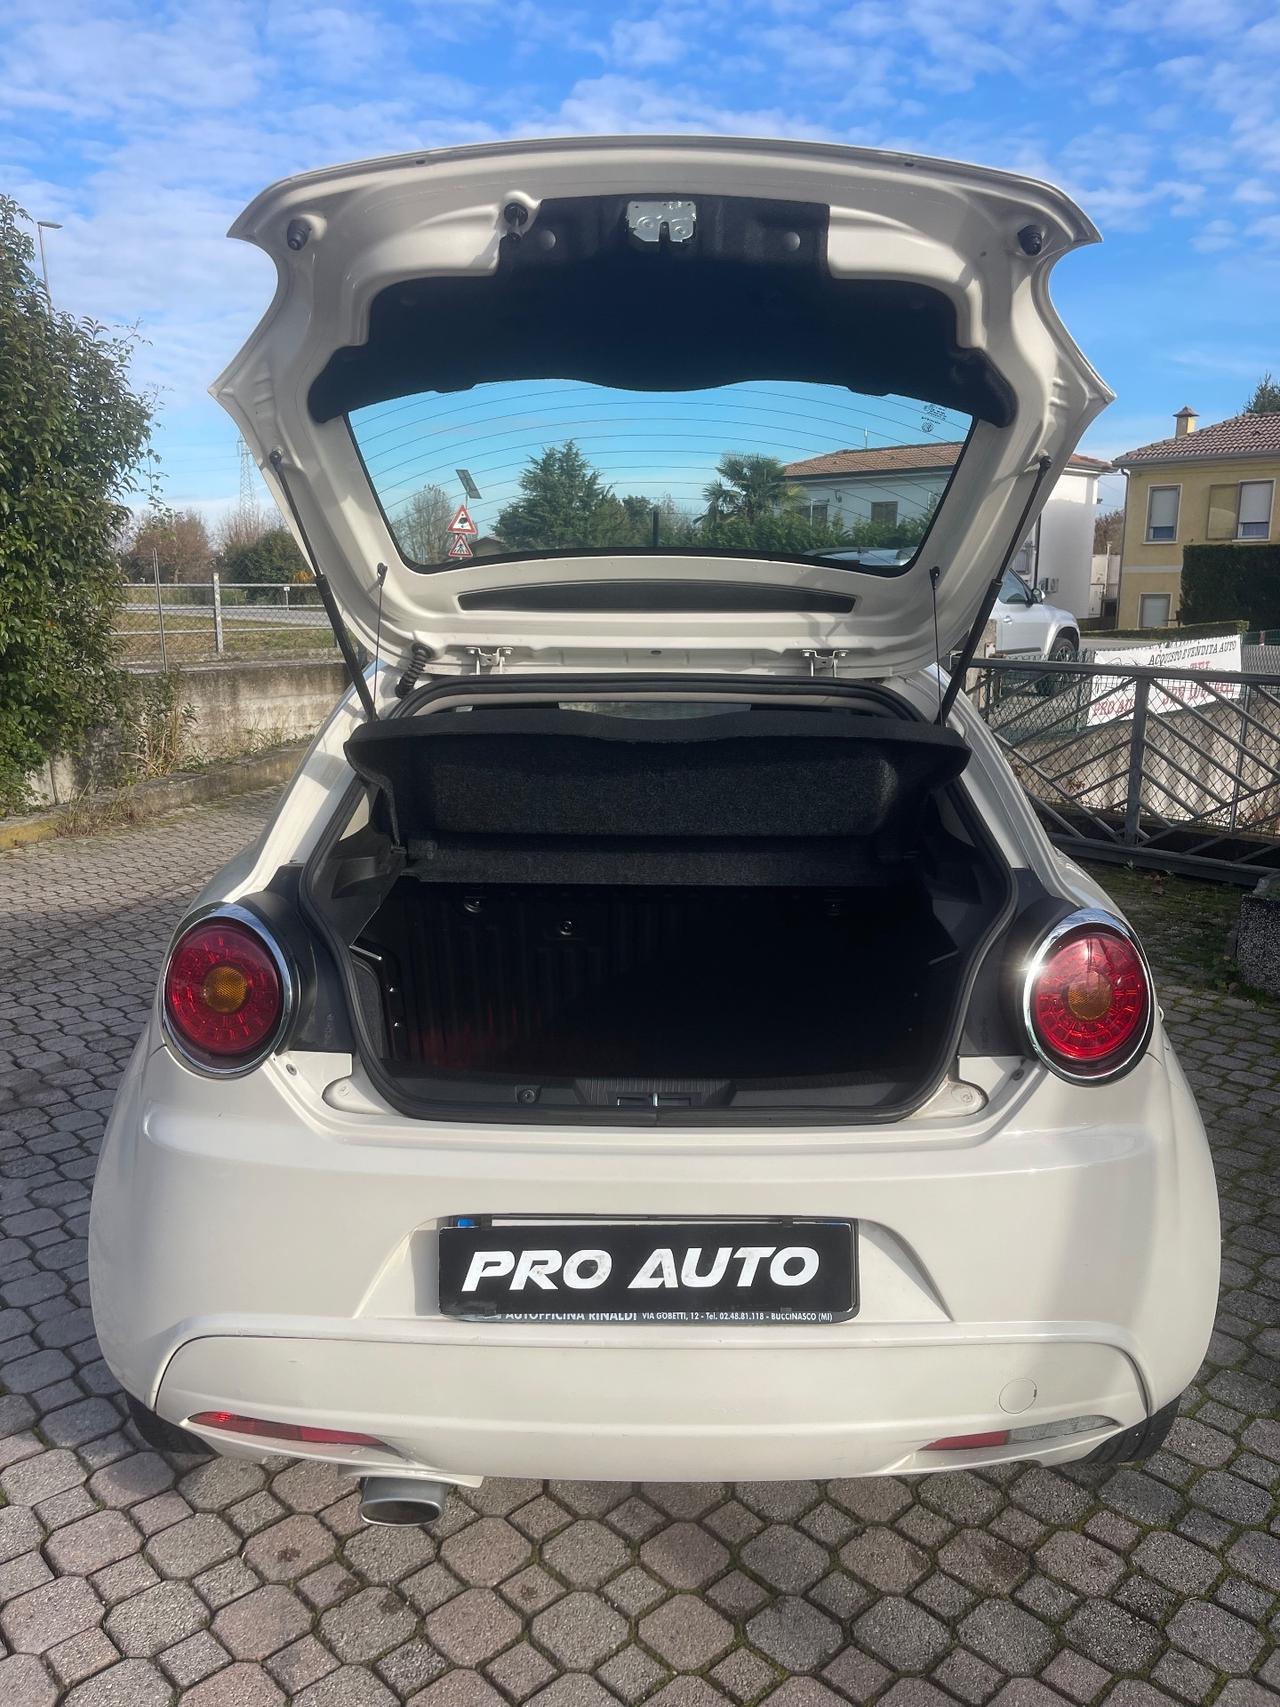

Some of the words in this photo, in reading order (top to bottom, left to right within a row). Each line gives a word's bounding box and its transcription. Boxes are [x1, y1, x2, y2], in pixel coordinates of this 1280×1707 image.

[1219, 640, 1237, 653] AUTO
[461, 1250, 612, 1292] PRO
[627, 1246, 820, 1289] AUTO
[656, 1312, 689, 1321] GOBETTI,
[771, 1313, 817, 1321] BUCCINASCO
[818, 1313, 833, 1322] (MI)
